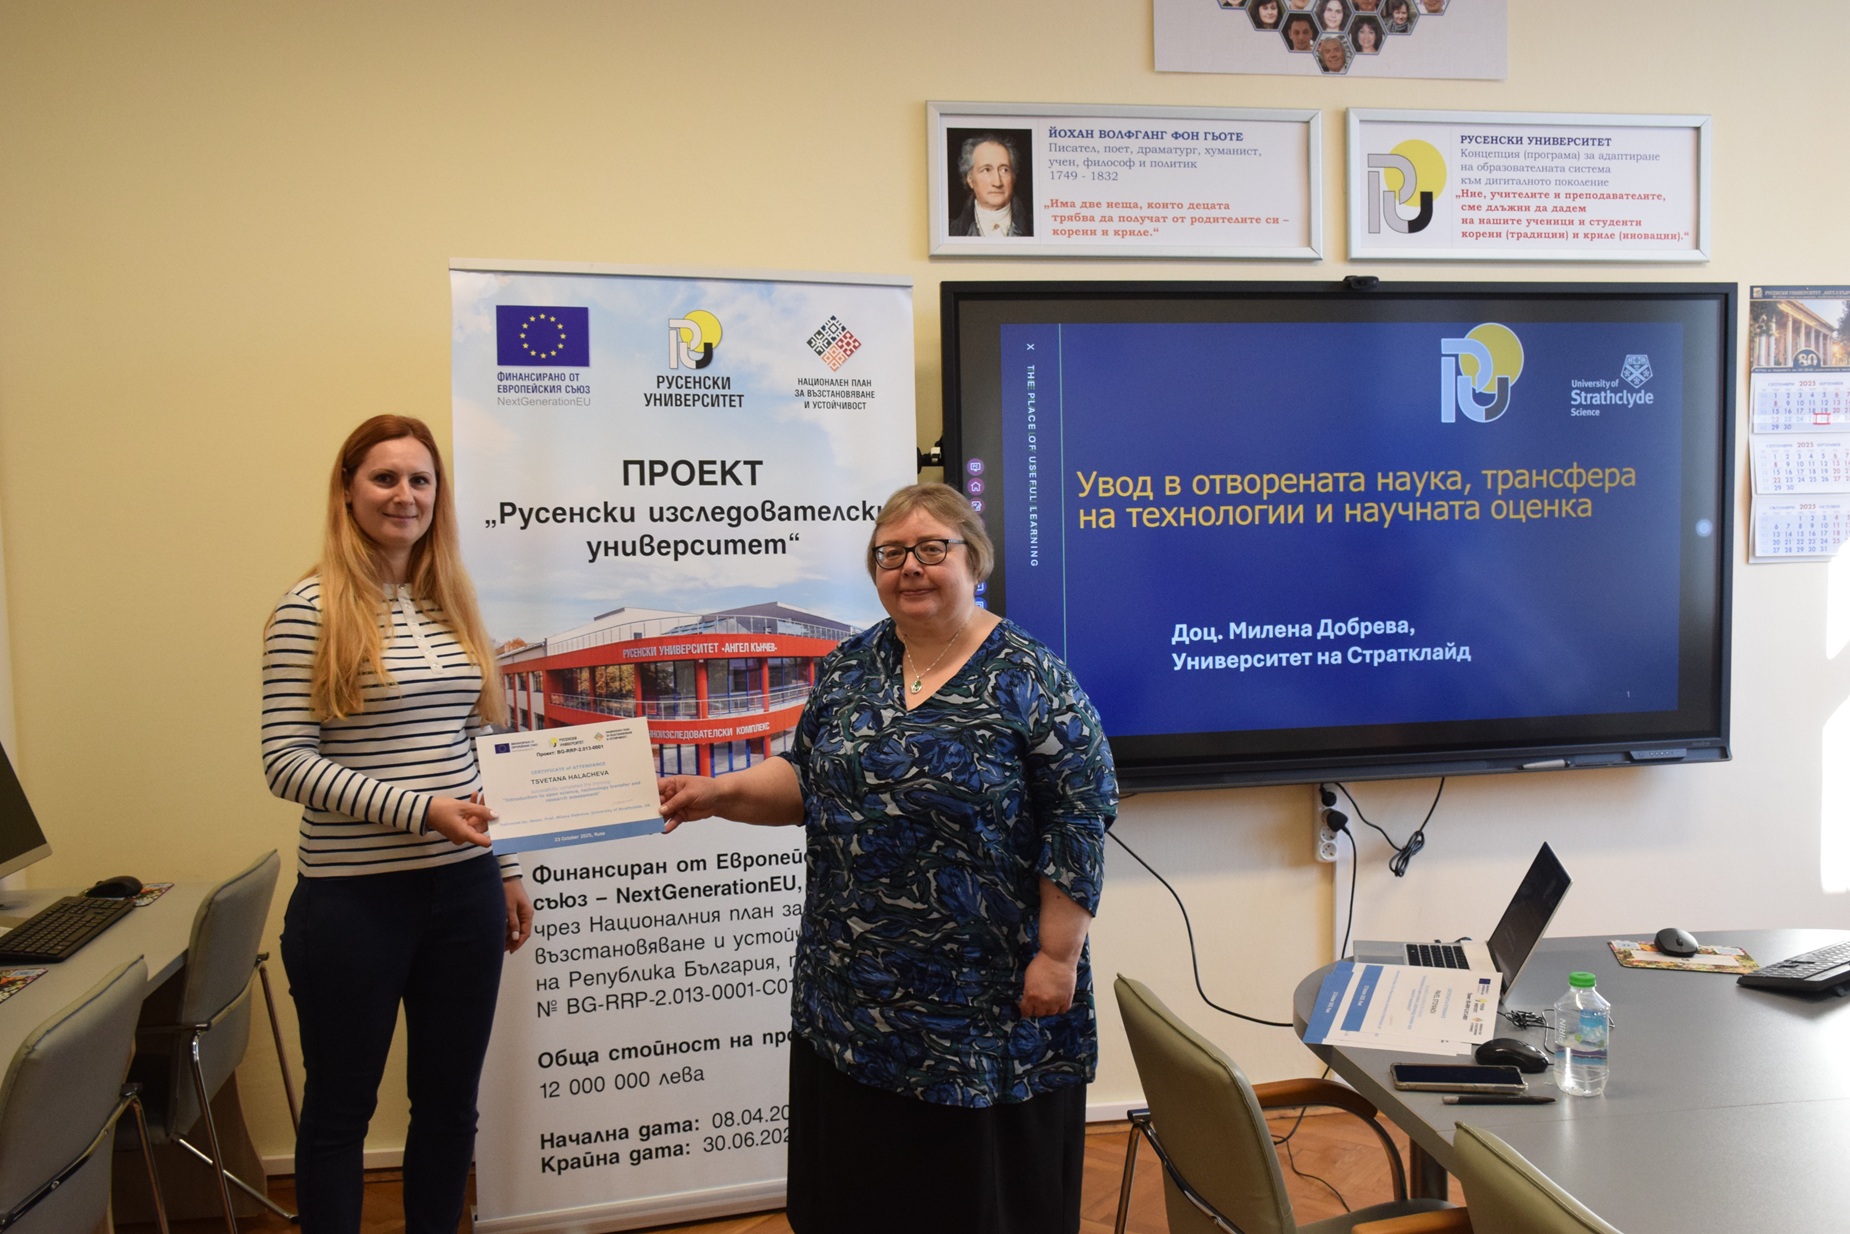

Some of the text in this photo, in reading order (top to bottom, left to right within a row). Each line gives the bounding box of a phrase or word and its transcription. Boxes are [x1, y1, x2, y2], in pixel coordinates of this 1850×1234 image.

[1048, 127, 1243, 142] ЙОХАН ВОЛФГАНГ ФОН ГЬОТЕ
[1460, 136, 1612, 147] РУСЕНСКИ УНИВЕРСИТЕТ
[1048, 142, 1262, 159] Писател, поет, драматург, хуманист,
[1460, 149, 1660, 163] Концепция (програма) за адаптиране
[1048, 157, 1198, 170] учен, философ и политик
[1460, 162, 1611, 174] на образователната система
[1050, 171, 1078, 181] 1749
[1090, 171, 1119, 182] 1832
[1460, 177, 1609, 188] към дигиталното поколение
[1455, 190, 1666, 203] „Ние, учителите и преподавателите,
[1044, 199, 1230, 213] „Има две неща, които децата
[1461, 203, 1587, 214] сме длъжни да дадем
[1051, 213, 1096, 224] трябва
[1099, 215, 1114, 225] да
[1118, 215, 1169, 226] получат
[1172, 215, 1186, 225] от
[1189, 216, 1262, 226] родителите
[1265, 217, 1280, 225] си
[1461, 217, 1642, 229] на нашите ученици и студенти
[1051, 228, 1160, 239] корени и криле.“
[1461, 230, 1690, 243] корени (традиции) и криле (иновации).“
[1798, 354, 1817, 366] 80
[497, 372, 580, 383] ФИНАНСИРАНО ОТ
[656, 375, 731, 390] РУСЕНСКИ
[797, 377, 872, 387] НАЦИОНАЛЕН ПЛАН
[1571, 379, 1619, 388] University of
[497, 383, 591, 394] ЕВРОПЕЙСКИЯ СЪЮЗ
[794, 389, 876, 399] ЗА ВЪЗСТАНОВЯВАНЕ
[497, 396, 591, 408] NextGenerationEU
[644, 392, 745, 409] УНИВЕРСИТЕТ
[804, 400, 867, 410] И УСТОЙЧИВОСТ
[1571, 390, 1654, 408] Strathclyde
[1571, 408, 1600, 416] Science
[1026, 343, 1038, 567] X THE PLACE OF USEFUL LEARNING
[622, 459, 763, 487] ПРОЕКТ
[1076, 462, 1636, 501] Увод в отворената наука, трансфера
[485, 501, 635, 530] „Русенски
[1079, 498, 1592, 529] на технологии и научната оценка
[586, 532, 800, 563] университет“
[1172, 616, 1415, 645] Доц. Милена Добрева,
[623, 647, 657, 658] РУСЕНСКИ
[659, 643, 719, 656] УНИВЕРСИТЕТ
[1172, 641, 1471, 673] Университет на Стратклайд
[736, 722, 770, 735] КОМПЛЕКС
[531, 770, 609, 785] TSVETANA HALACHEVA
[532, 860, 667, 885] Финансиран
[676, 856, 707, 872] от
[533, 892, 588, 911] съюз
[616, 875, 802, 904] NextGenerationEU,
[534, 904, 802, 939] чрез Националния план за
[534, 936, 706, 964] възстановяване
[714, 934, 724, 948] и
[536, 976, 559, 991] на
[569, 964, 675, 989] Република
[684, 956, 780, 978] България,
[537, 978, 794, 1018] № BG-RRP-2.013-0001-C0
[1557, 1018, 1566, 1044] PIRIN
[538, 1048, 599, 1069] Обща
[609, 1035, 720, 1061] стойност
[730, 1034, 753, 1048] на
[540, 1066, 705, 1098] 12 000 000 лева
[540, 1126, 629, 1150] Начална
[639, 1118, 701, 1139] дата:
[541, 1154, 620, 1176] Крайна
[629, 1142, 691, 1164] дата:
